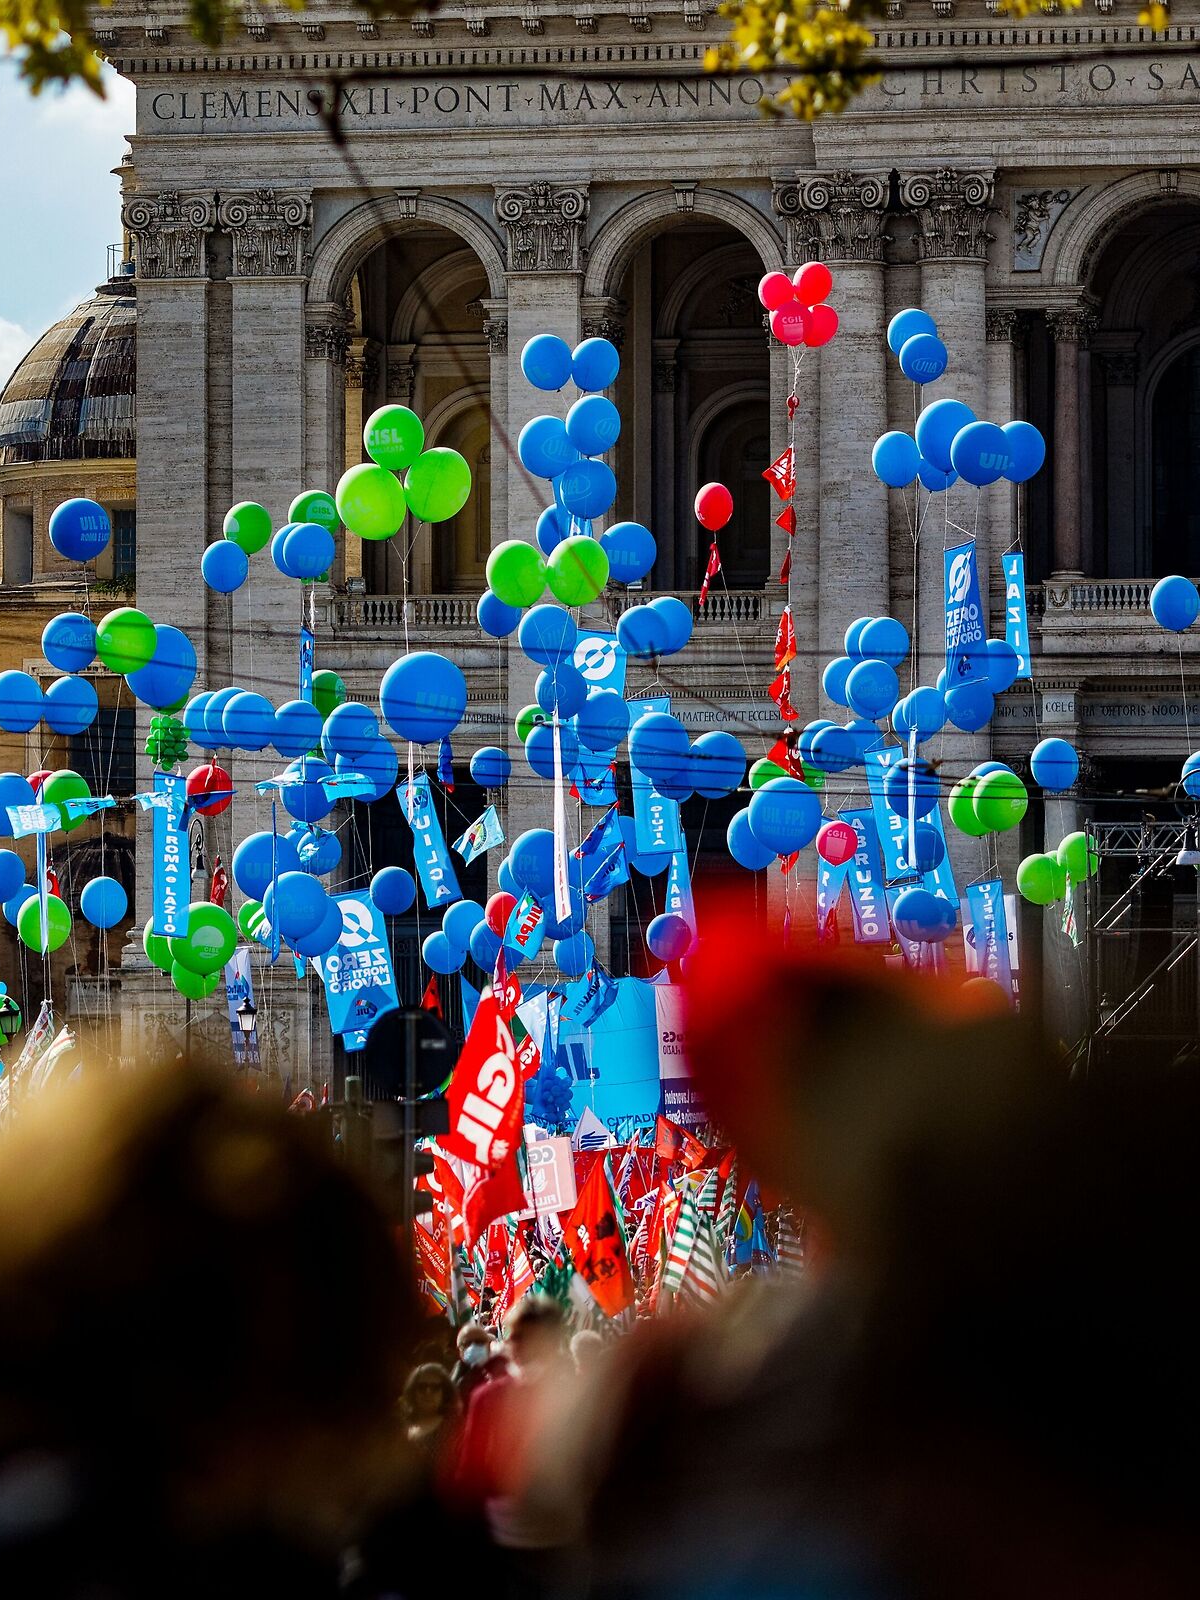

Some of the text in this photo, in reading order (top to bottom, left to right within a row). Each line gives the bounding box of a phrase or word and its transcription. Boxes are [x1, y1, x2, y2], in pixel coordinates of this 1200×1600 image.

[879, 63, 1116, 96] CHRISTO
[152, 88, 321, 120] CLEMENS
[340, 86, 390, 116] XII
[410, 82, 520, 114] PONT
[538, 81, 628, 112] MAX
[647, 78, 764, 109] ANNO
[781, 315, 804, 325] CGIL
[311, 506, 332, 516] CISL
[80, 515, 98, 531] UIL
[610, 549, 641, 566] UIL
[946, 602, 979, 628] ZERO
[946, 630, 982, 650] LAVORO
[415, 691, 457, 715] UIL
[464, 713, 508, 724] IMPERIAL
[686, 711, 715, 722] MATER
[716, 710, 747, 722] CAPVT
[748, 709, 783, 722] ECCLESI
[826, 829, 848, 840] CGIL
[163, 835, 179, 873] ROMA
[165, 876, 177, 885] e
[850, 818, 879, 936] ABRUZZO
[163, 888, 177, 933] LAZIO
